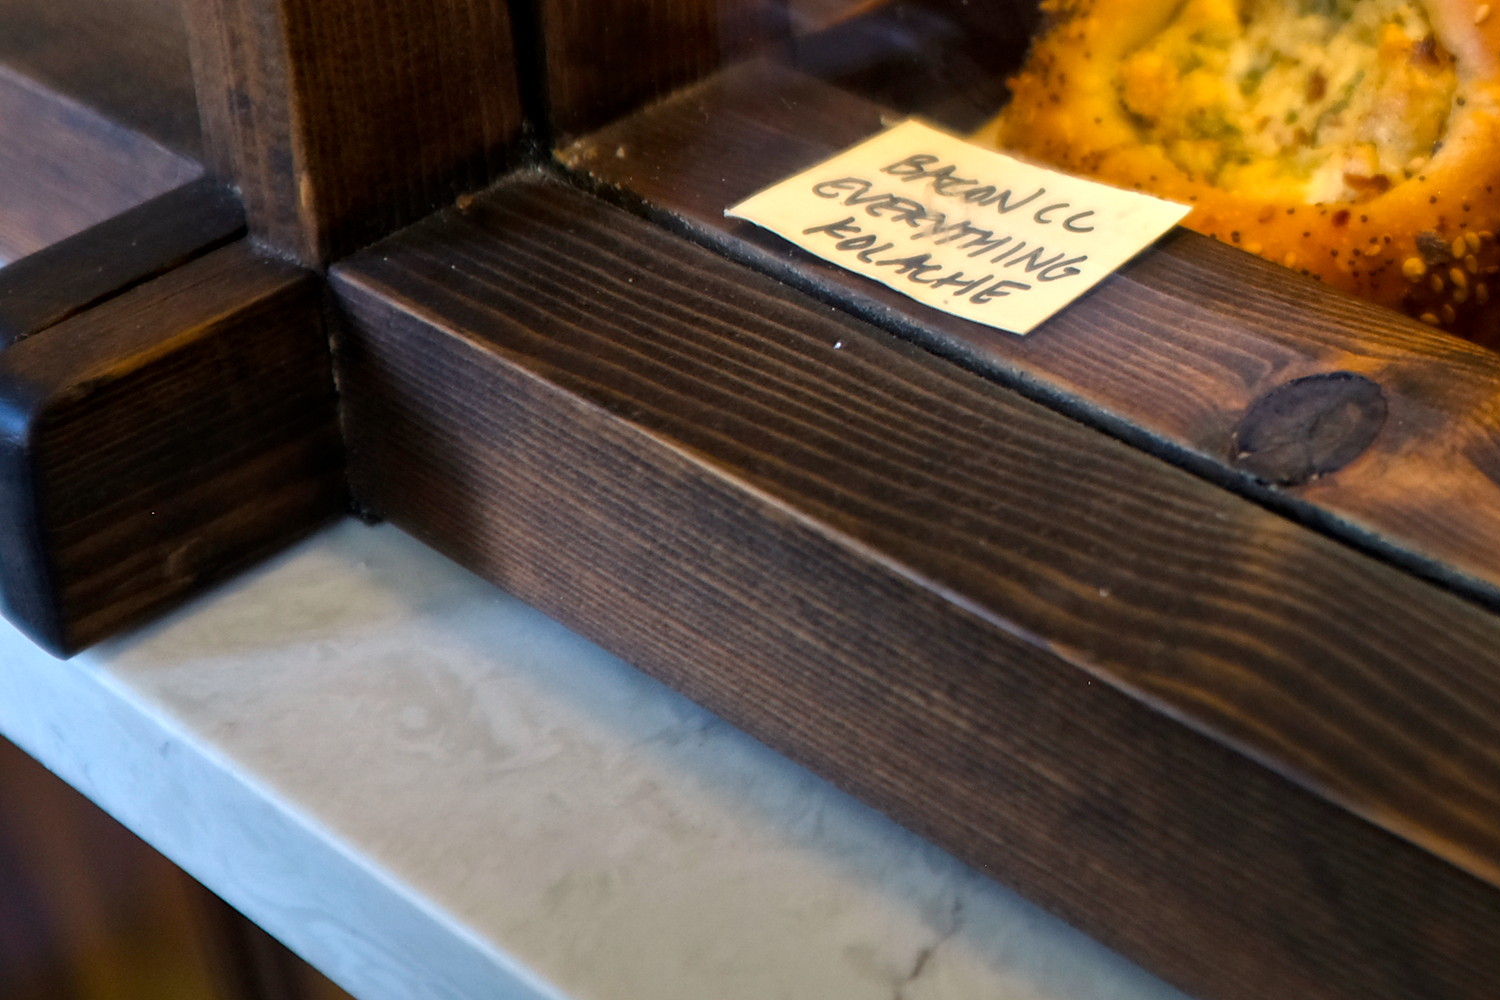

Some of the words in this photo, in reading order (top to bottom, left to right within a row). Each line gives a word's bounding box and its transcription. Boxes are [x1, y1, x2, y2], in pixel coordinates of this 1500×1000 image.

[880, 154, 1046, 216] BACON
[801, 216, 1031, 304] KOLACHE
[812, 177, 1088, 282] EVERYTHING
